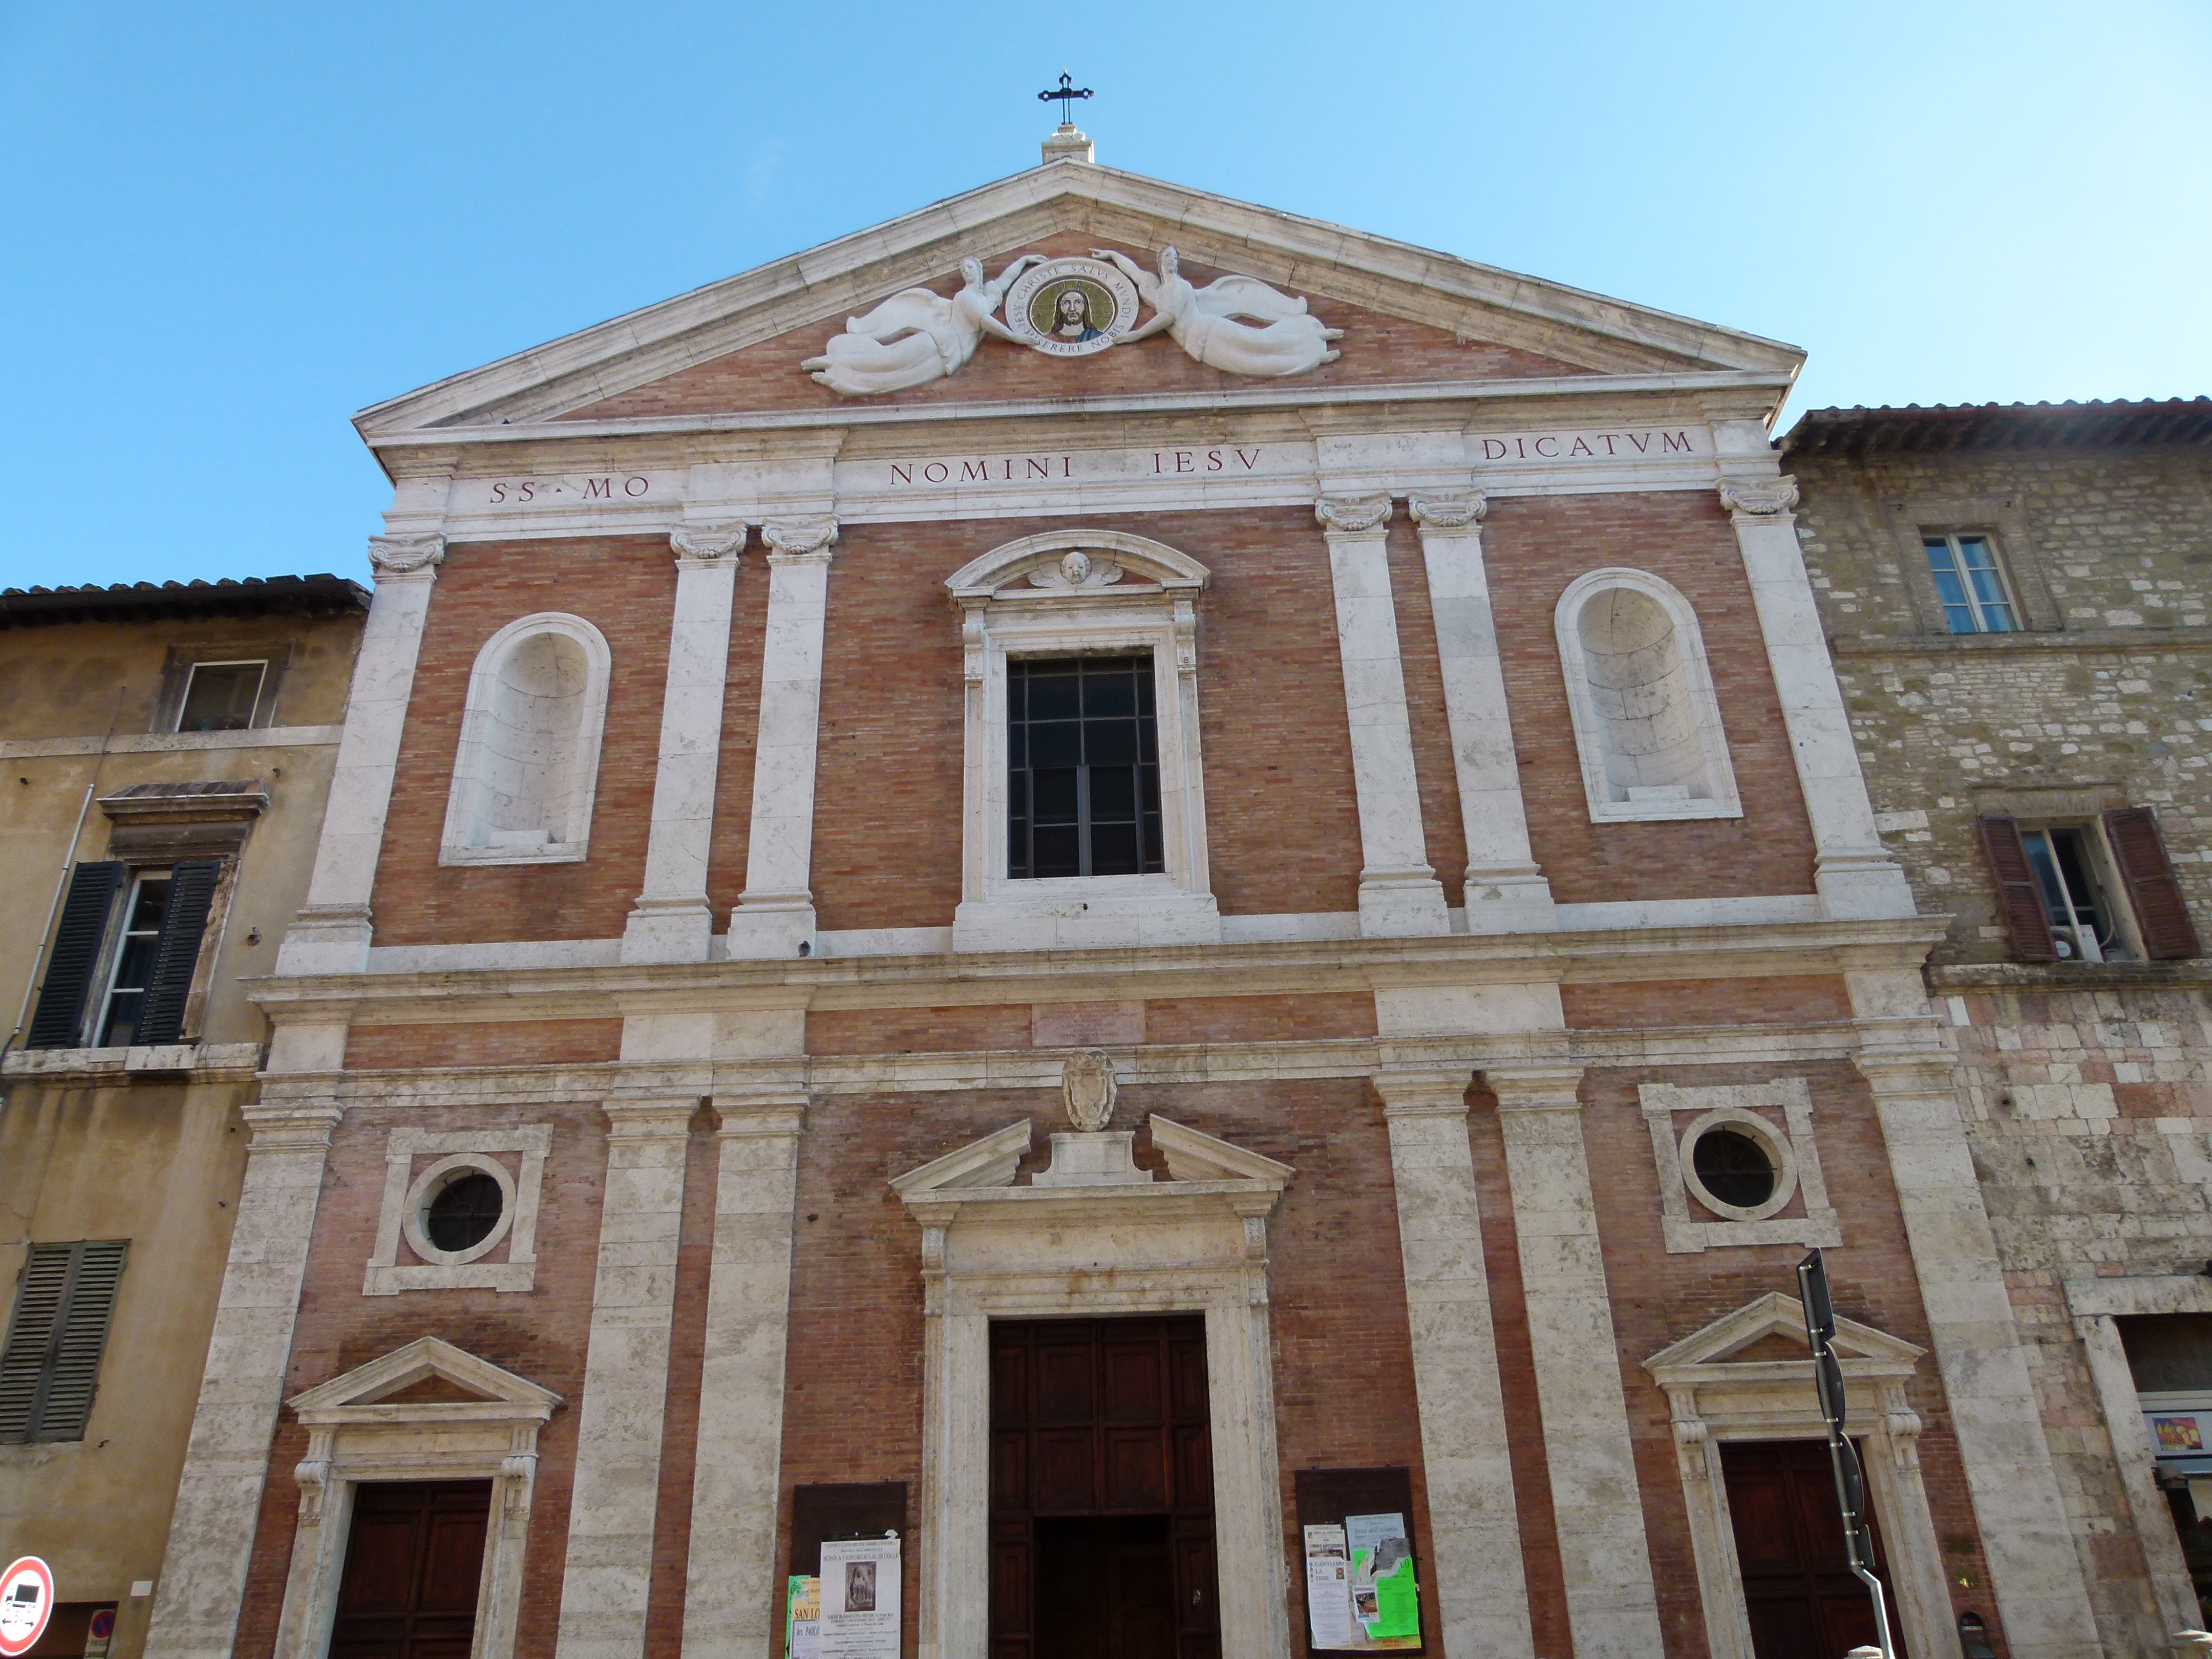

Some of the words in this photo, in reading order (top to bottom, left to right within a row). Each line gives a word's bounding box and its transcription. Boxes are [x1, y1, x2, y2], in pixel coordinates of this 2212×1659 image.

[1017, 268, 1060, 300] CHRISTE
[1071, 265, 1109, 279] SALVS
[1113, 282, 1131, 319] MVNDI
[1091, 324, 1124, 348] NOBIS
[1482, 431, 1694, 460] DICATVM
[890, 456, 1072, 486] NOMINI
[1153, 449, 1261, 474] IESV
[794, 1609, 809, 1619] SAN
